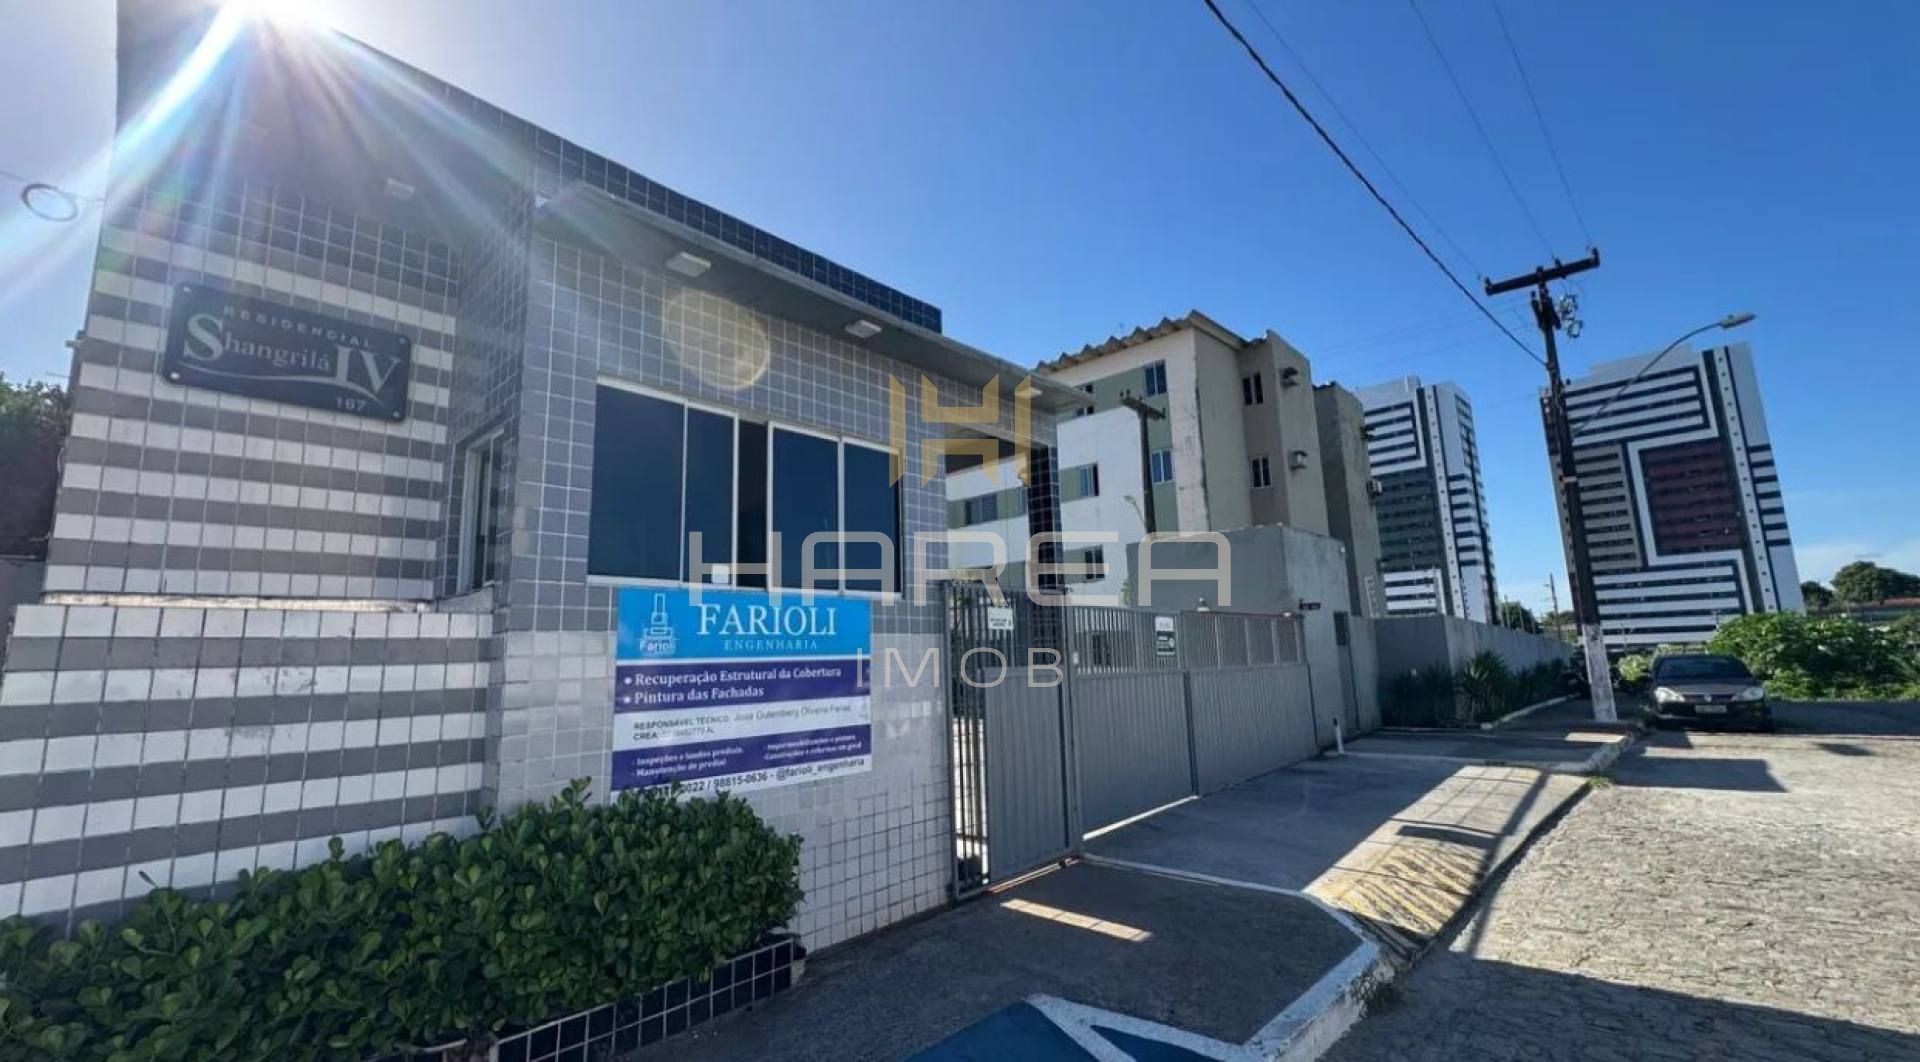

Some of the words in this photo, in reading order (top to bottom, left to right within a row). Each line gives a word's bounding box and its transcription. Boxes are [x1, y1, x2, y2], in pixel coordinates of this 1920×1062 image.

[223, 304, 372, 348] RESIDENCIAL
[182, 312, 330, 371] Shangrilá
[335, 344, 401, 395] IV
[336, 396, 367, 412] 167
[696, 604, 837, 635] FARIOLI
[724, 639, 817, 651] ENGENHARIA
[635, 671, 718, 688] Recuperação
[720, 668, 777, 682] Estrutural
[778, 667, 791, 679] da
[792, 665, 842, 679] Cobertura
[634, 690, 684, 705] Pintura
[687, 687, 709, 701] das
[711, 685, 765, 699] Fachadas
